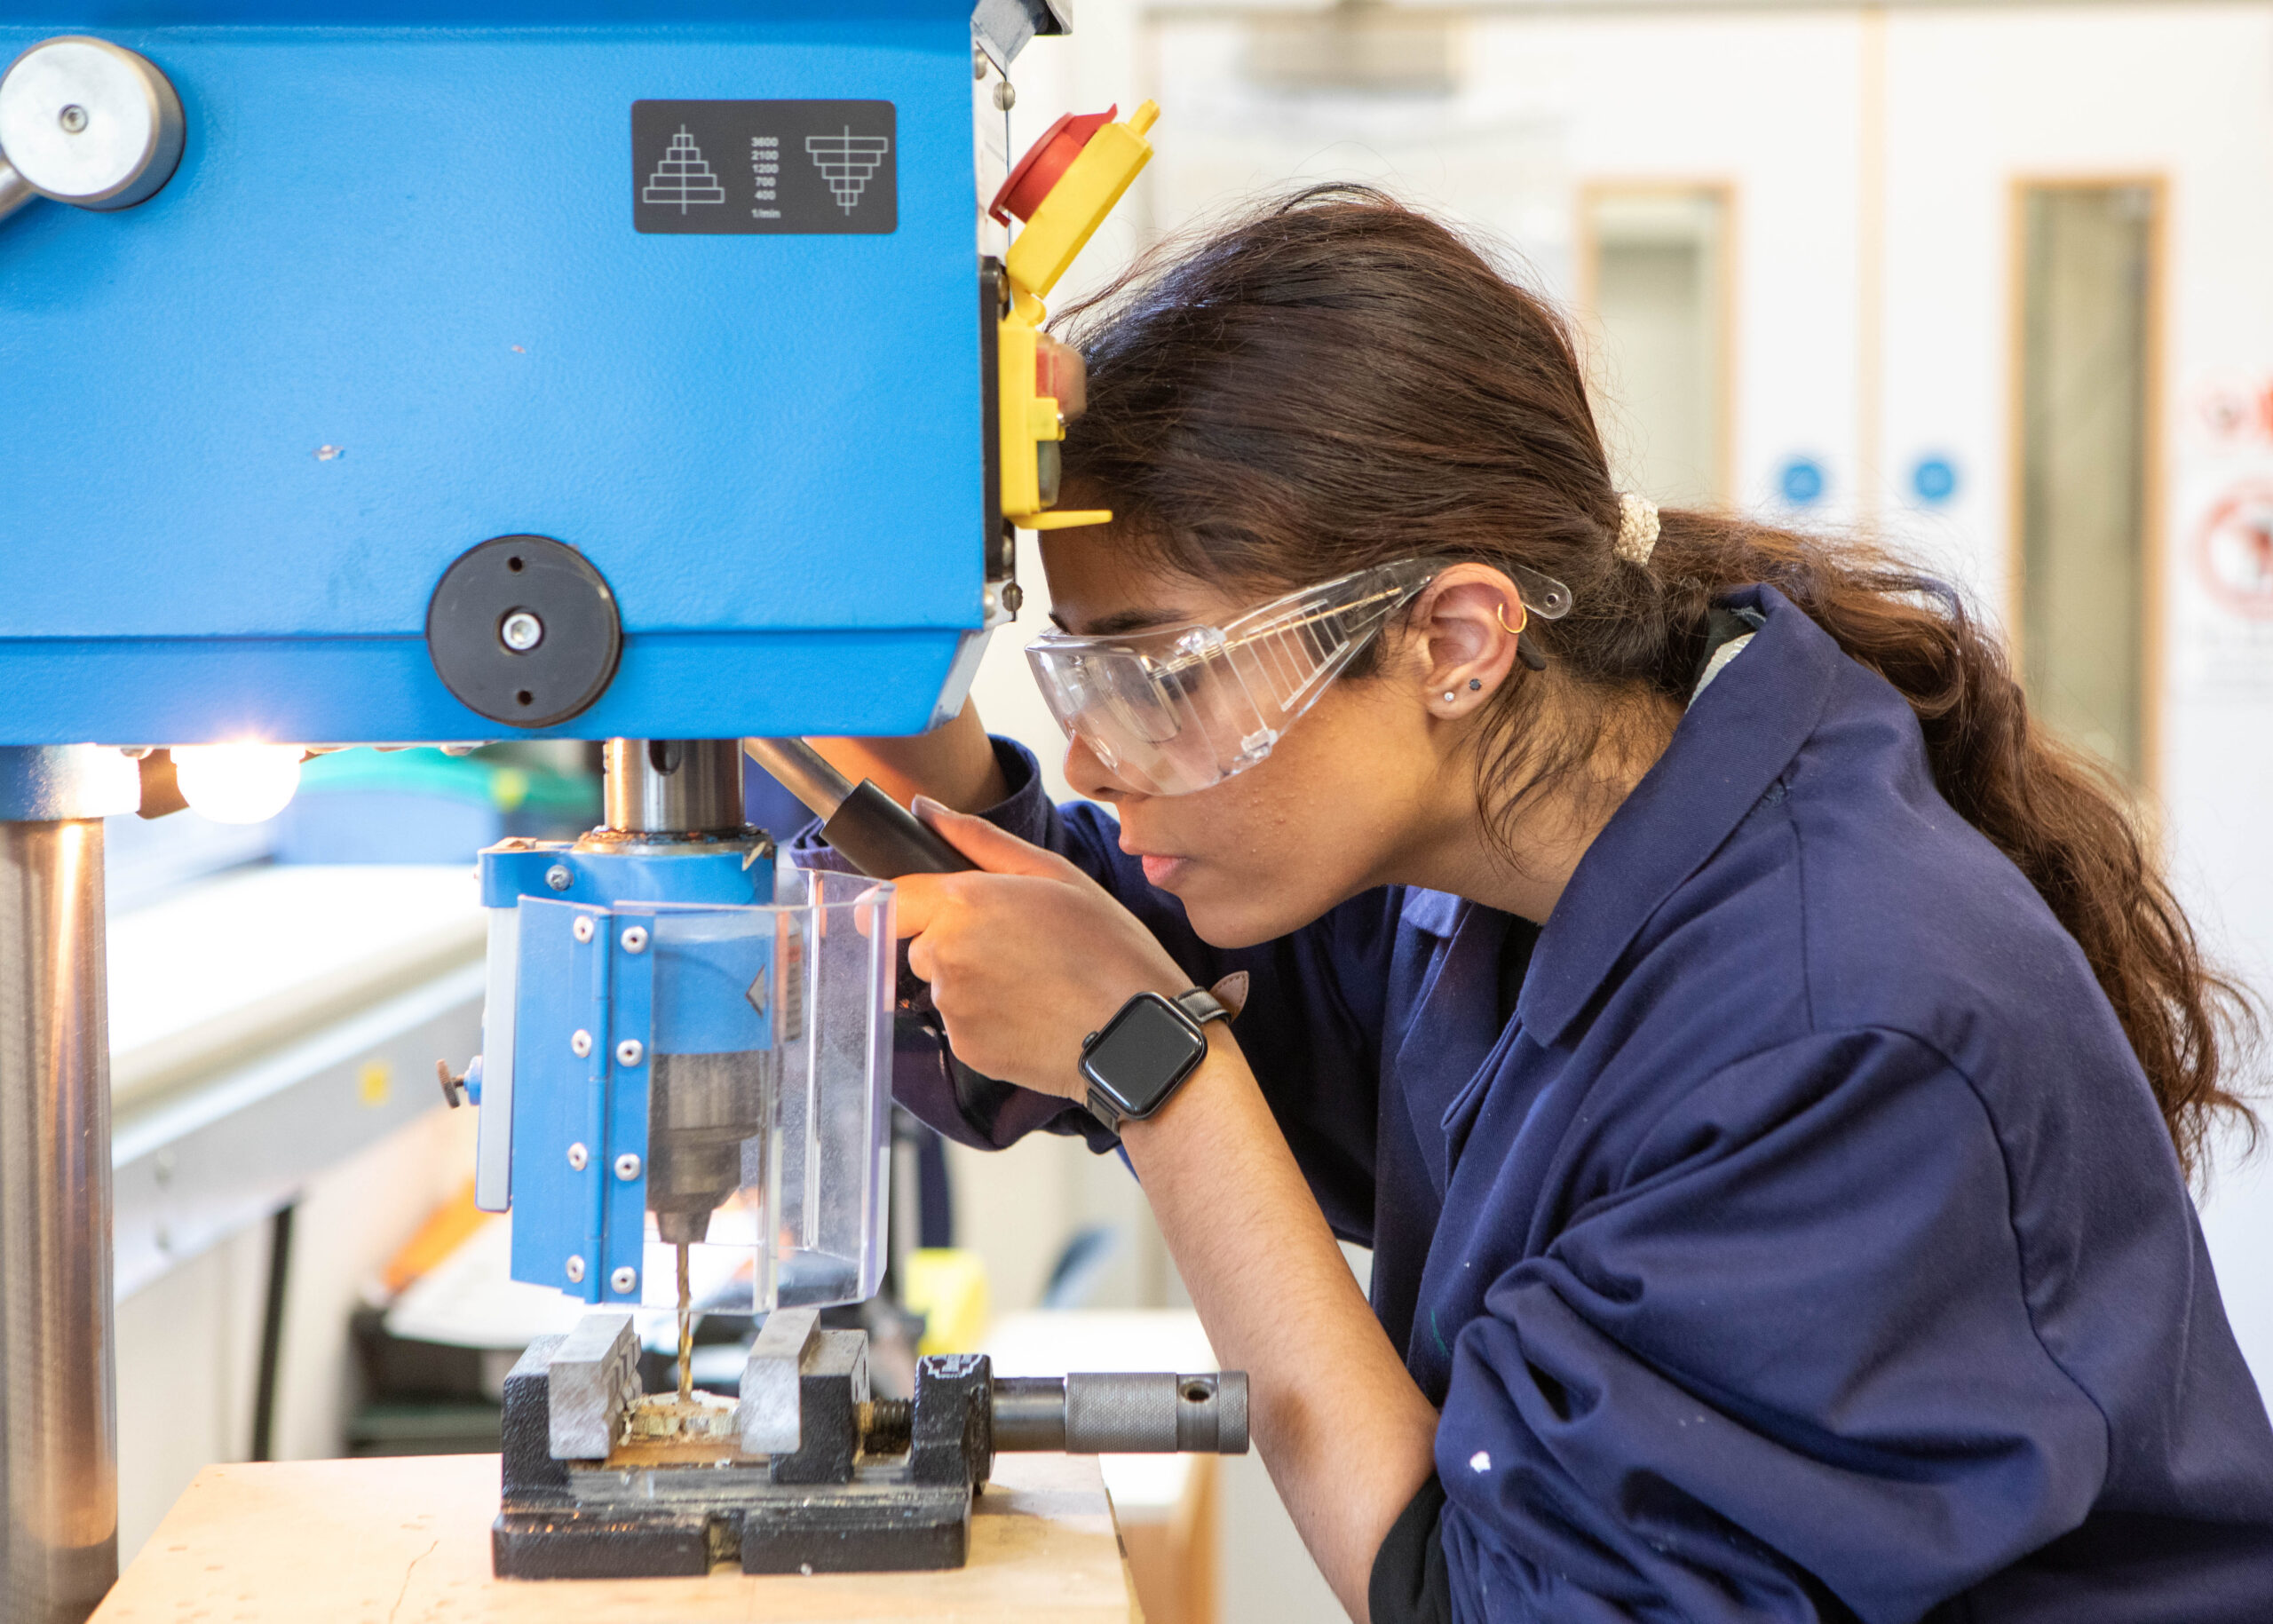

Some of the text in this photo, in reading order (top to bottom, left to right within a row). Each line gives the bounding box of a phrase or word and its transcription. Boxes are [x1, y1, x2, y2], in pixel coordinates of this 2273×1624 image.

[751, 150, 779, 161] 2100
[752, 163, 779, 174] 1200
[755, 177, 776, 187] 700
